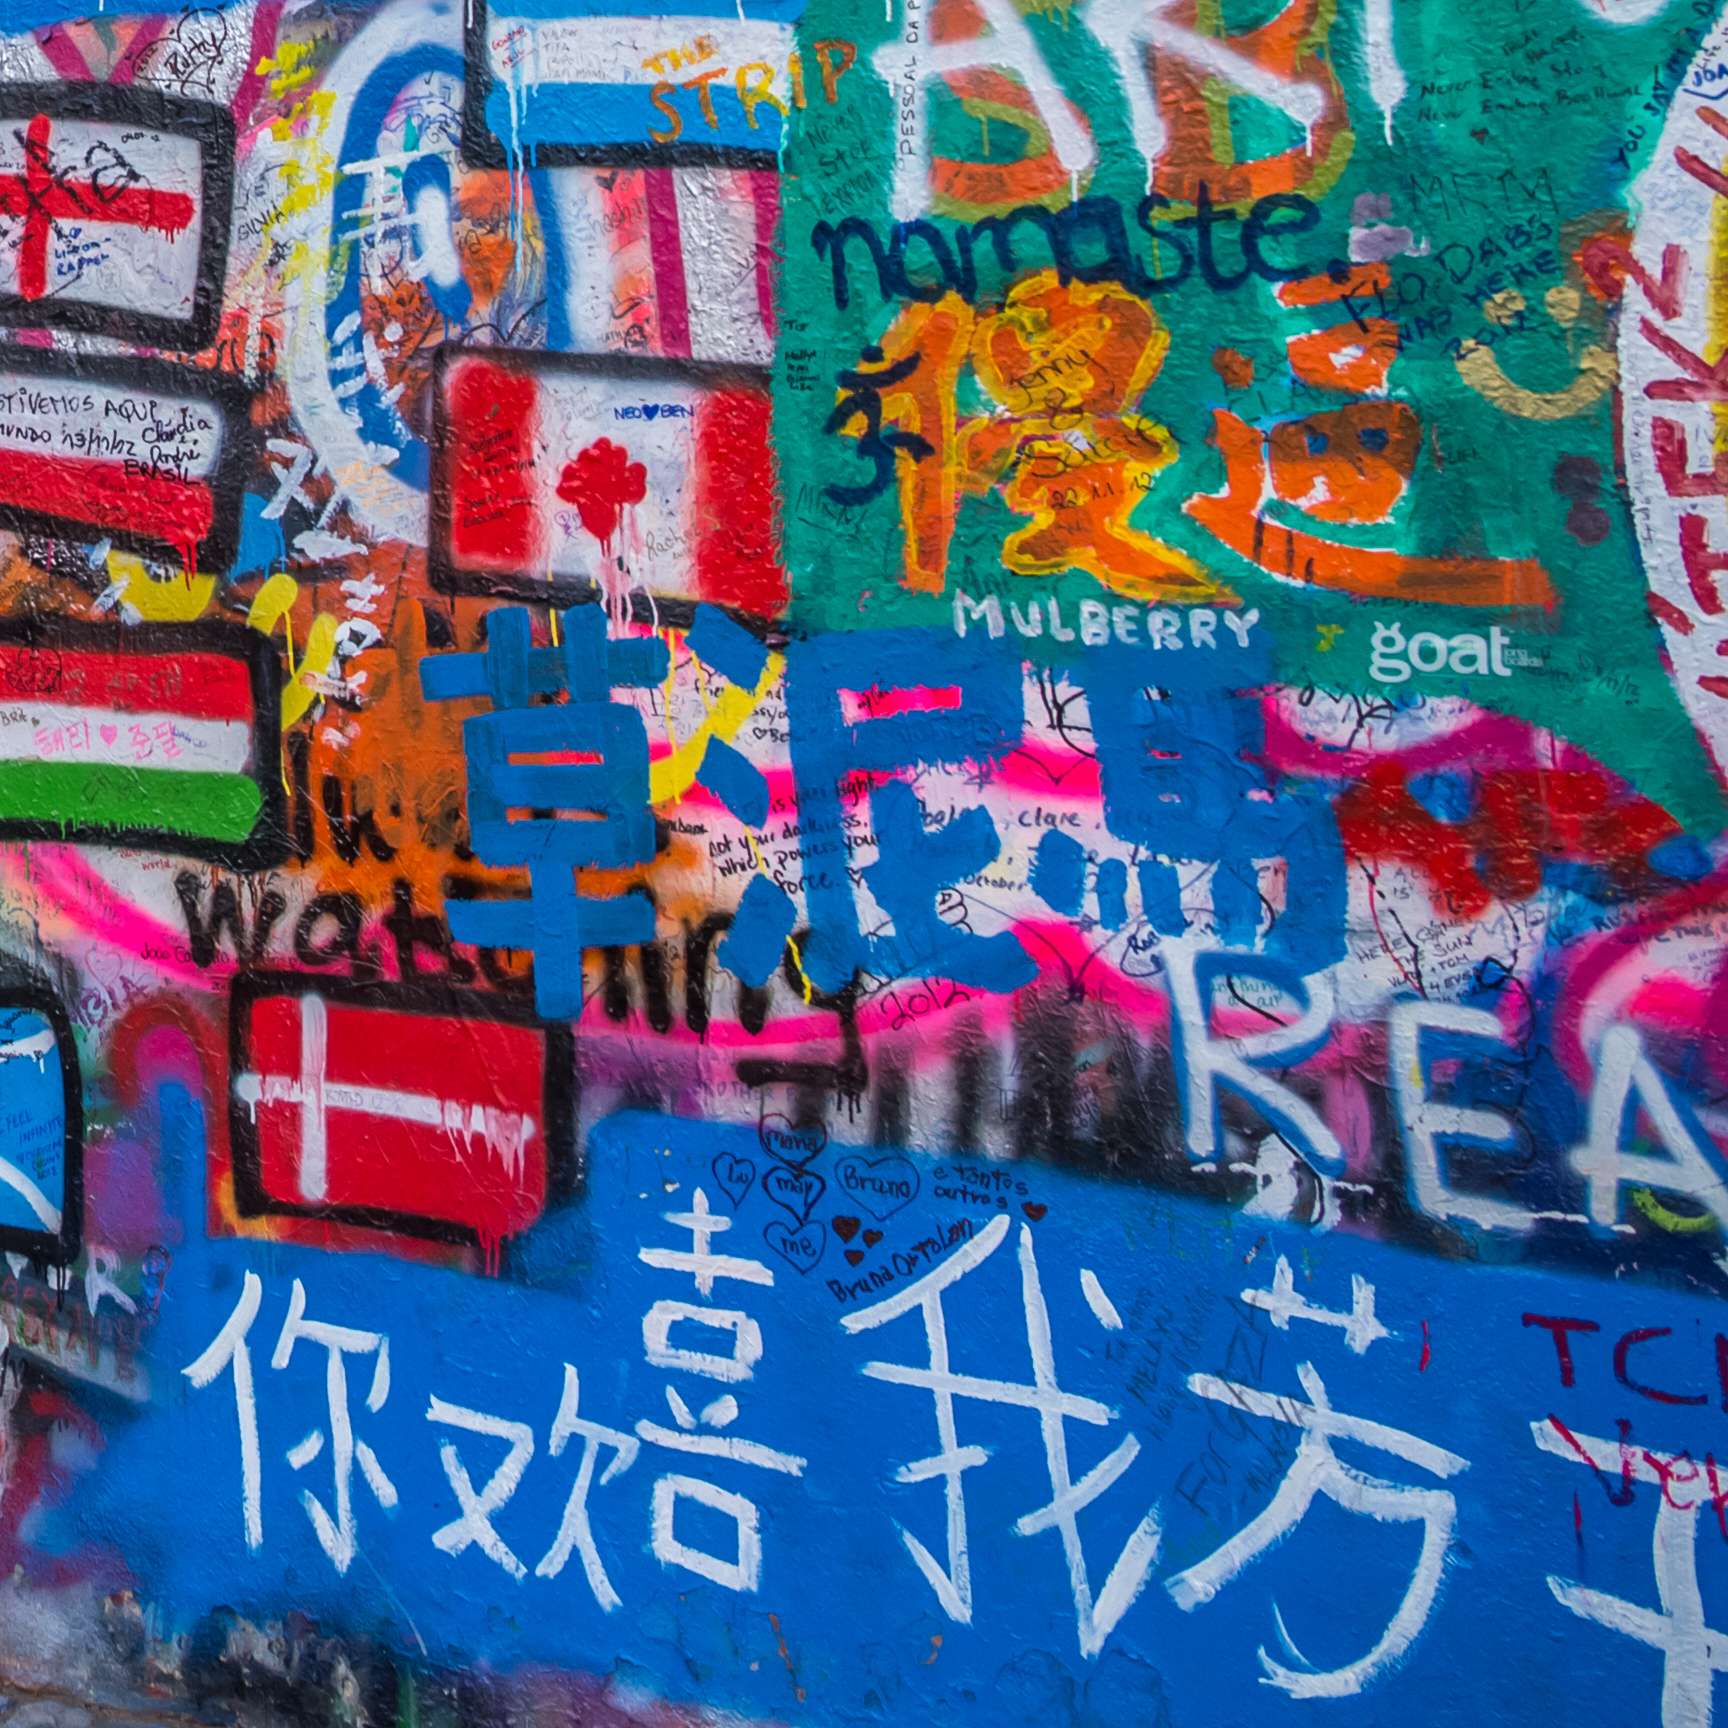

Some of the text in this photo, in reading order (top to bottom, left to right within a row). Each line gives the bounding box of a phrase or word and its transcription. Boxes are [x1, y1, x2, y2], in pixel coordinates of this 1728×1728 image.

[642, 33, 717, 77] THE
[648, 38, 858, 145] STRIP
[898, 49, 919, 158] PESSOAL
[659, 401, 696, 420] BEN
[950, 589, 1261, 653] MULBERRY
[1368, 620, 1513, 684] goat
[708, 835, 734, 858] not
[717, 852, 770, 878] which
[779, 1232, 818, 1258] me
